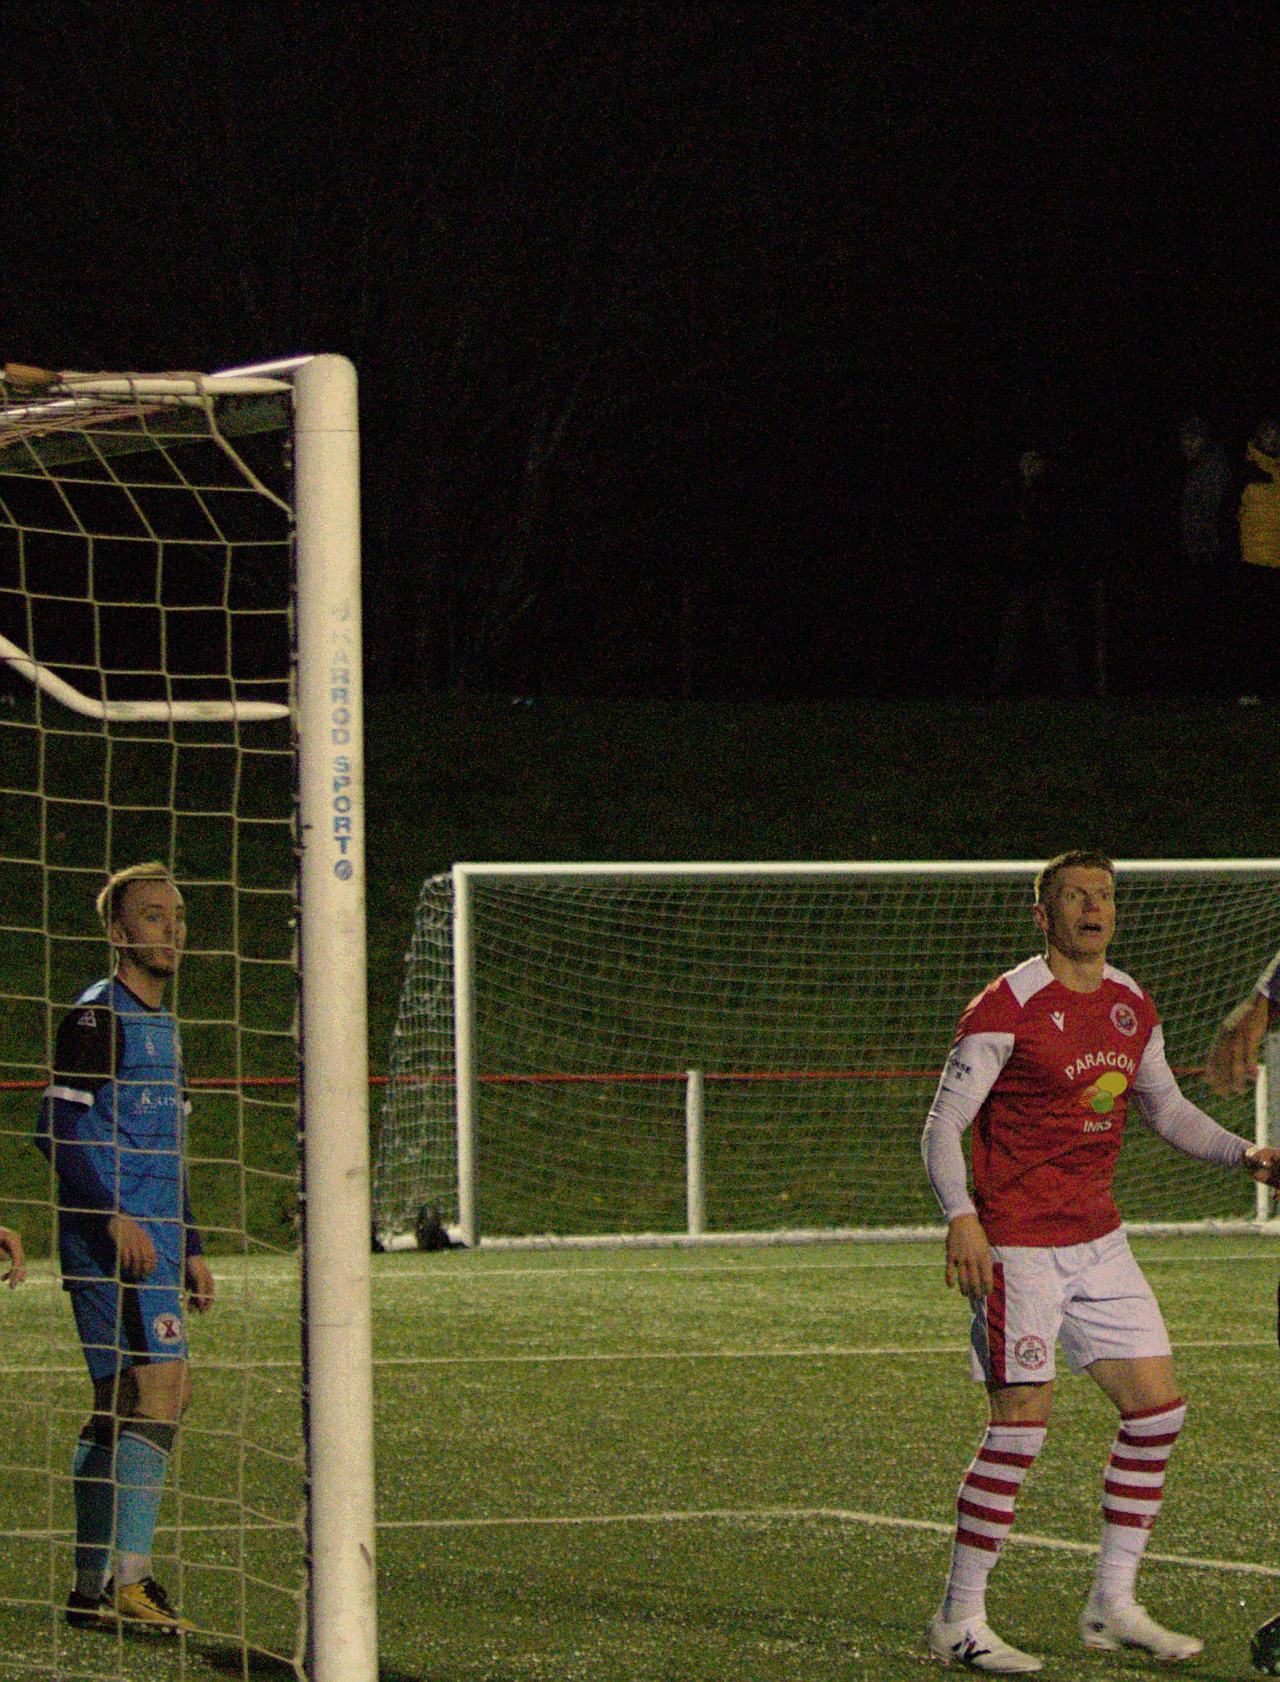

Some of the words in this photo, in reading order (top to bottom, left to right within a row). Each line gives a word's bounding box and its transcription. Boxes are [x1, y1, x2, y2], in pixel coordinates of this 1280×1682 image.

[333, 756, 351, 854] SPORT
[1063, 1051, 1137, 1080] PARAGON
[1082, 1121, 1112, 1133] INKS
